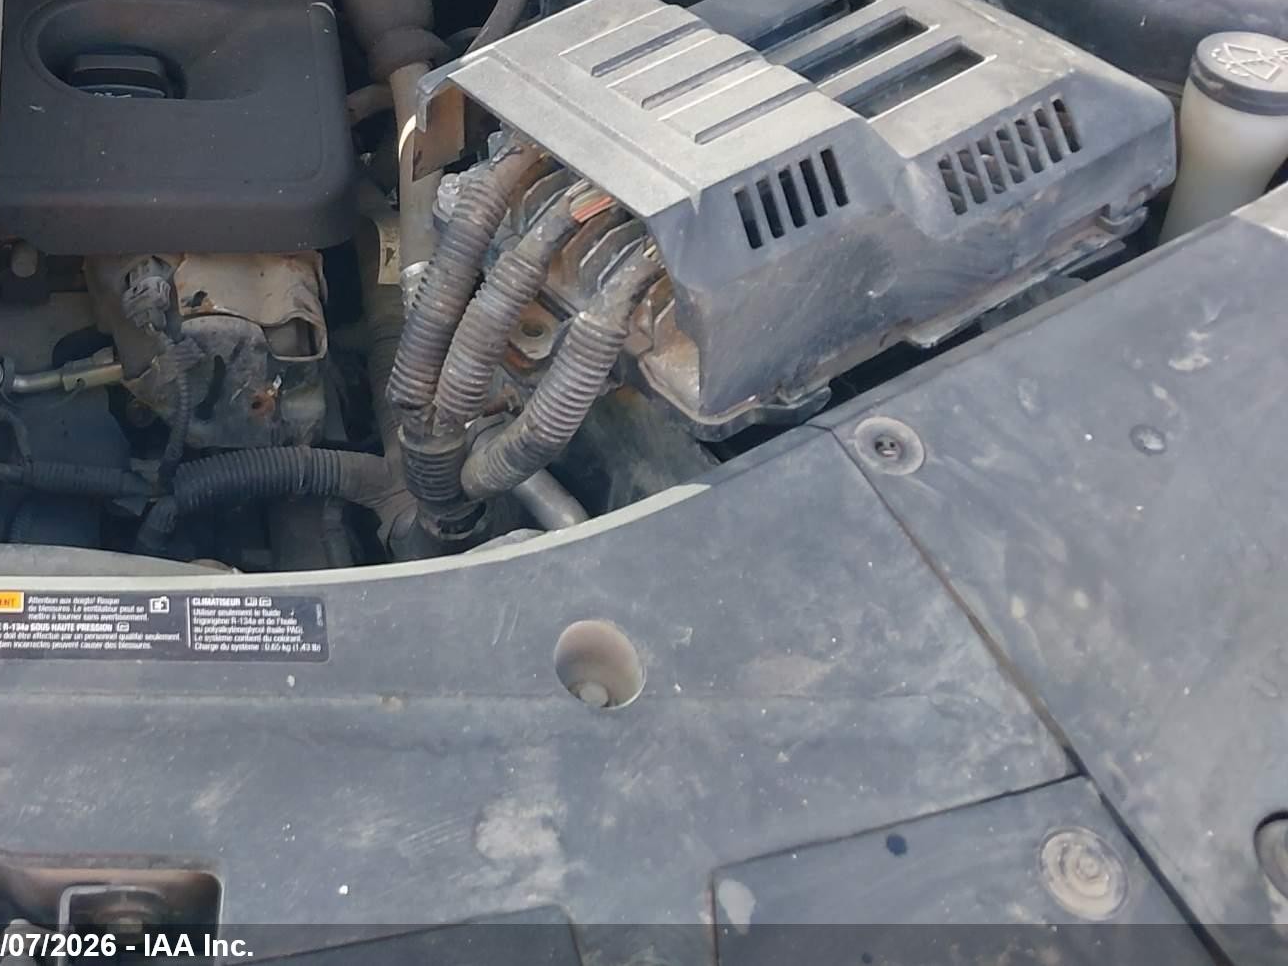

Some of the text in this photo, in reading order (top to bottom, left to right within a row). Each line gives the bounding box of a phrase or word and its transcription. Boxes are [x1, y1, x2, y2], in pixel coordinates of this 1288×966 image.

[193, 598, 240, 606] CLIMATISEUR
[30, 623, 50, 631] SOUS
[51, 623, 74, 631] HAUTE
[76, 623, 112, 632] PRESSION
[195, 643, 219, 651] Charge
